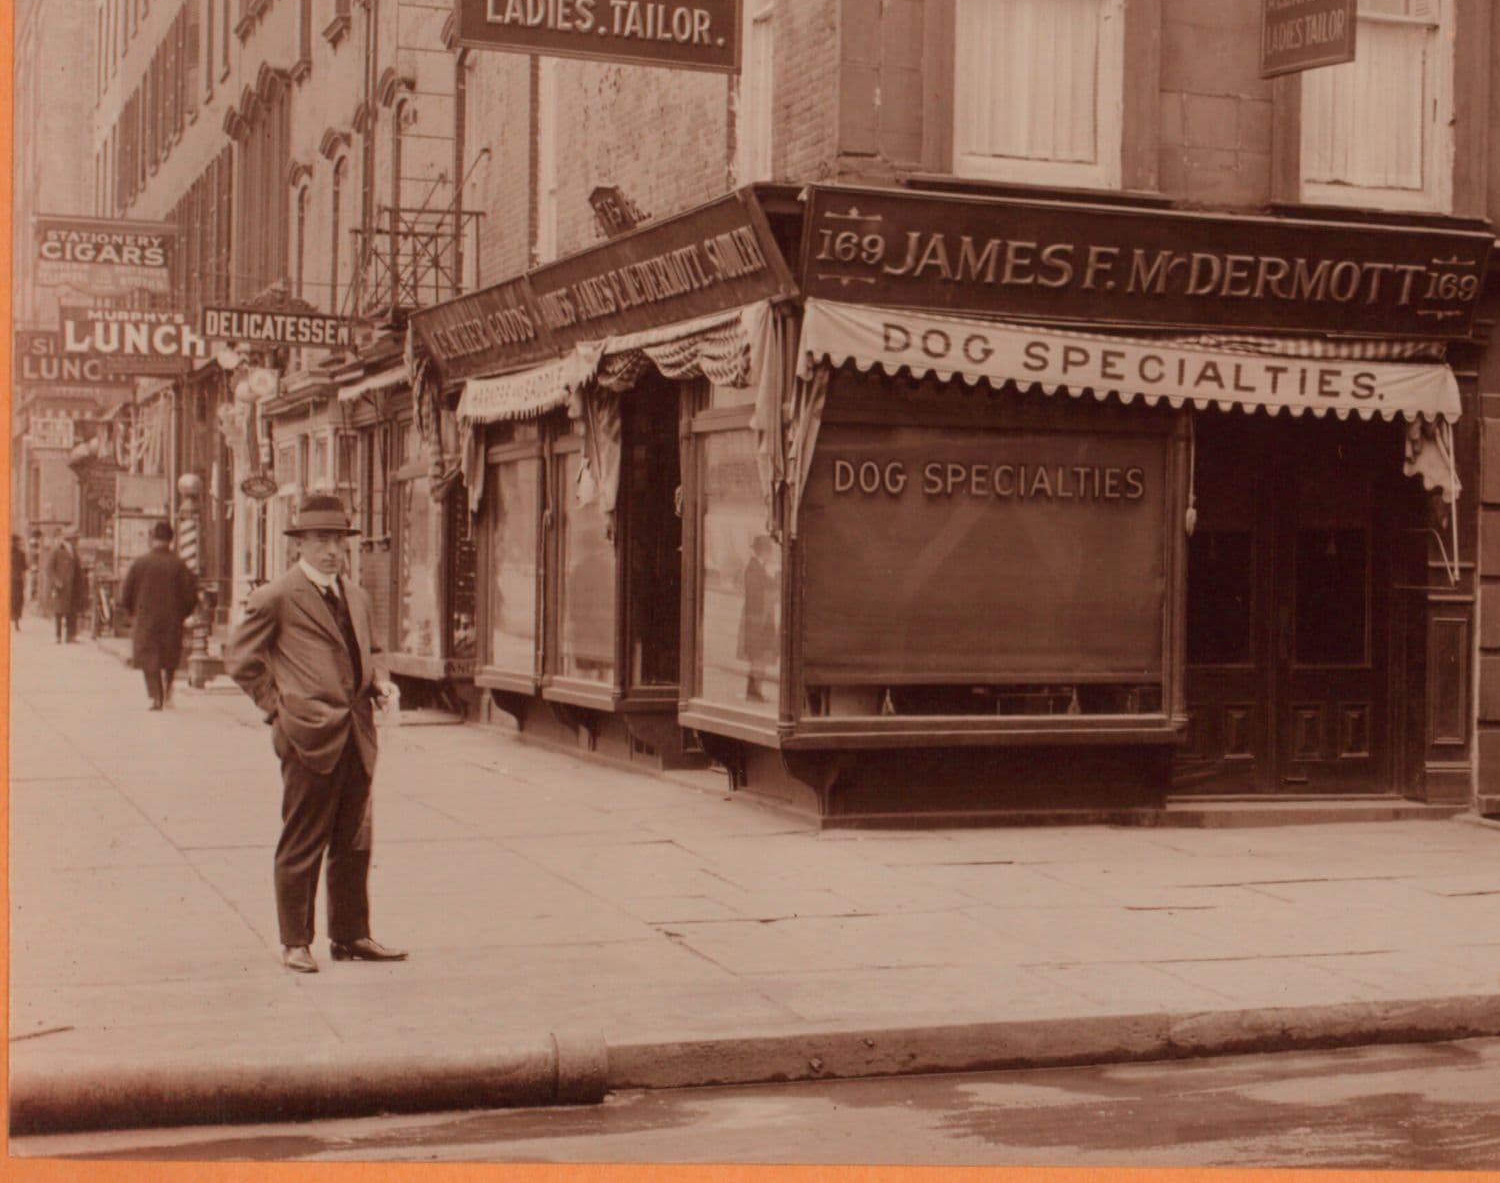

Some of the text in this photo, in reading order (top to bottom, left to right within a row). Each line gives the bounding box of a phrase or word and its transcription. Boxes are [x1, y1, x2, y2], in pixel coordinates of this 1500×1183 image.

[1266, 8, 1345, 55] LADIES TAILOR
[41, 241, 165, 266] CIGARS
[46, 230, 162, 248] STATIONERY
[816, 229, 885, 265] 169
[883, 231, 1075, 289] JAMES
[1082, 245, 1120, 291] F.
[1423, 271, 1480, 301] 169
[87, 310, 185, 324] MURPHY'S
[205, 309, 350, 346] DELICATESSEN
[22, 355, 126, 383] LUNC
[882, 321, 1387, 403] DOG SPECIALTIES.
[833, 460, 1146, 502] DOG SPECIALTIES
